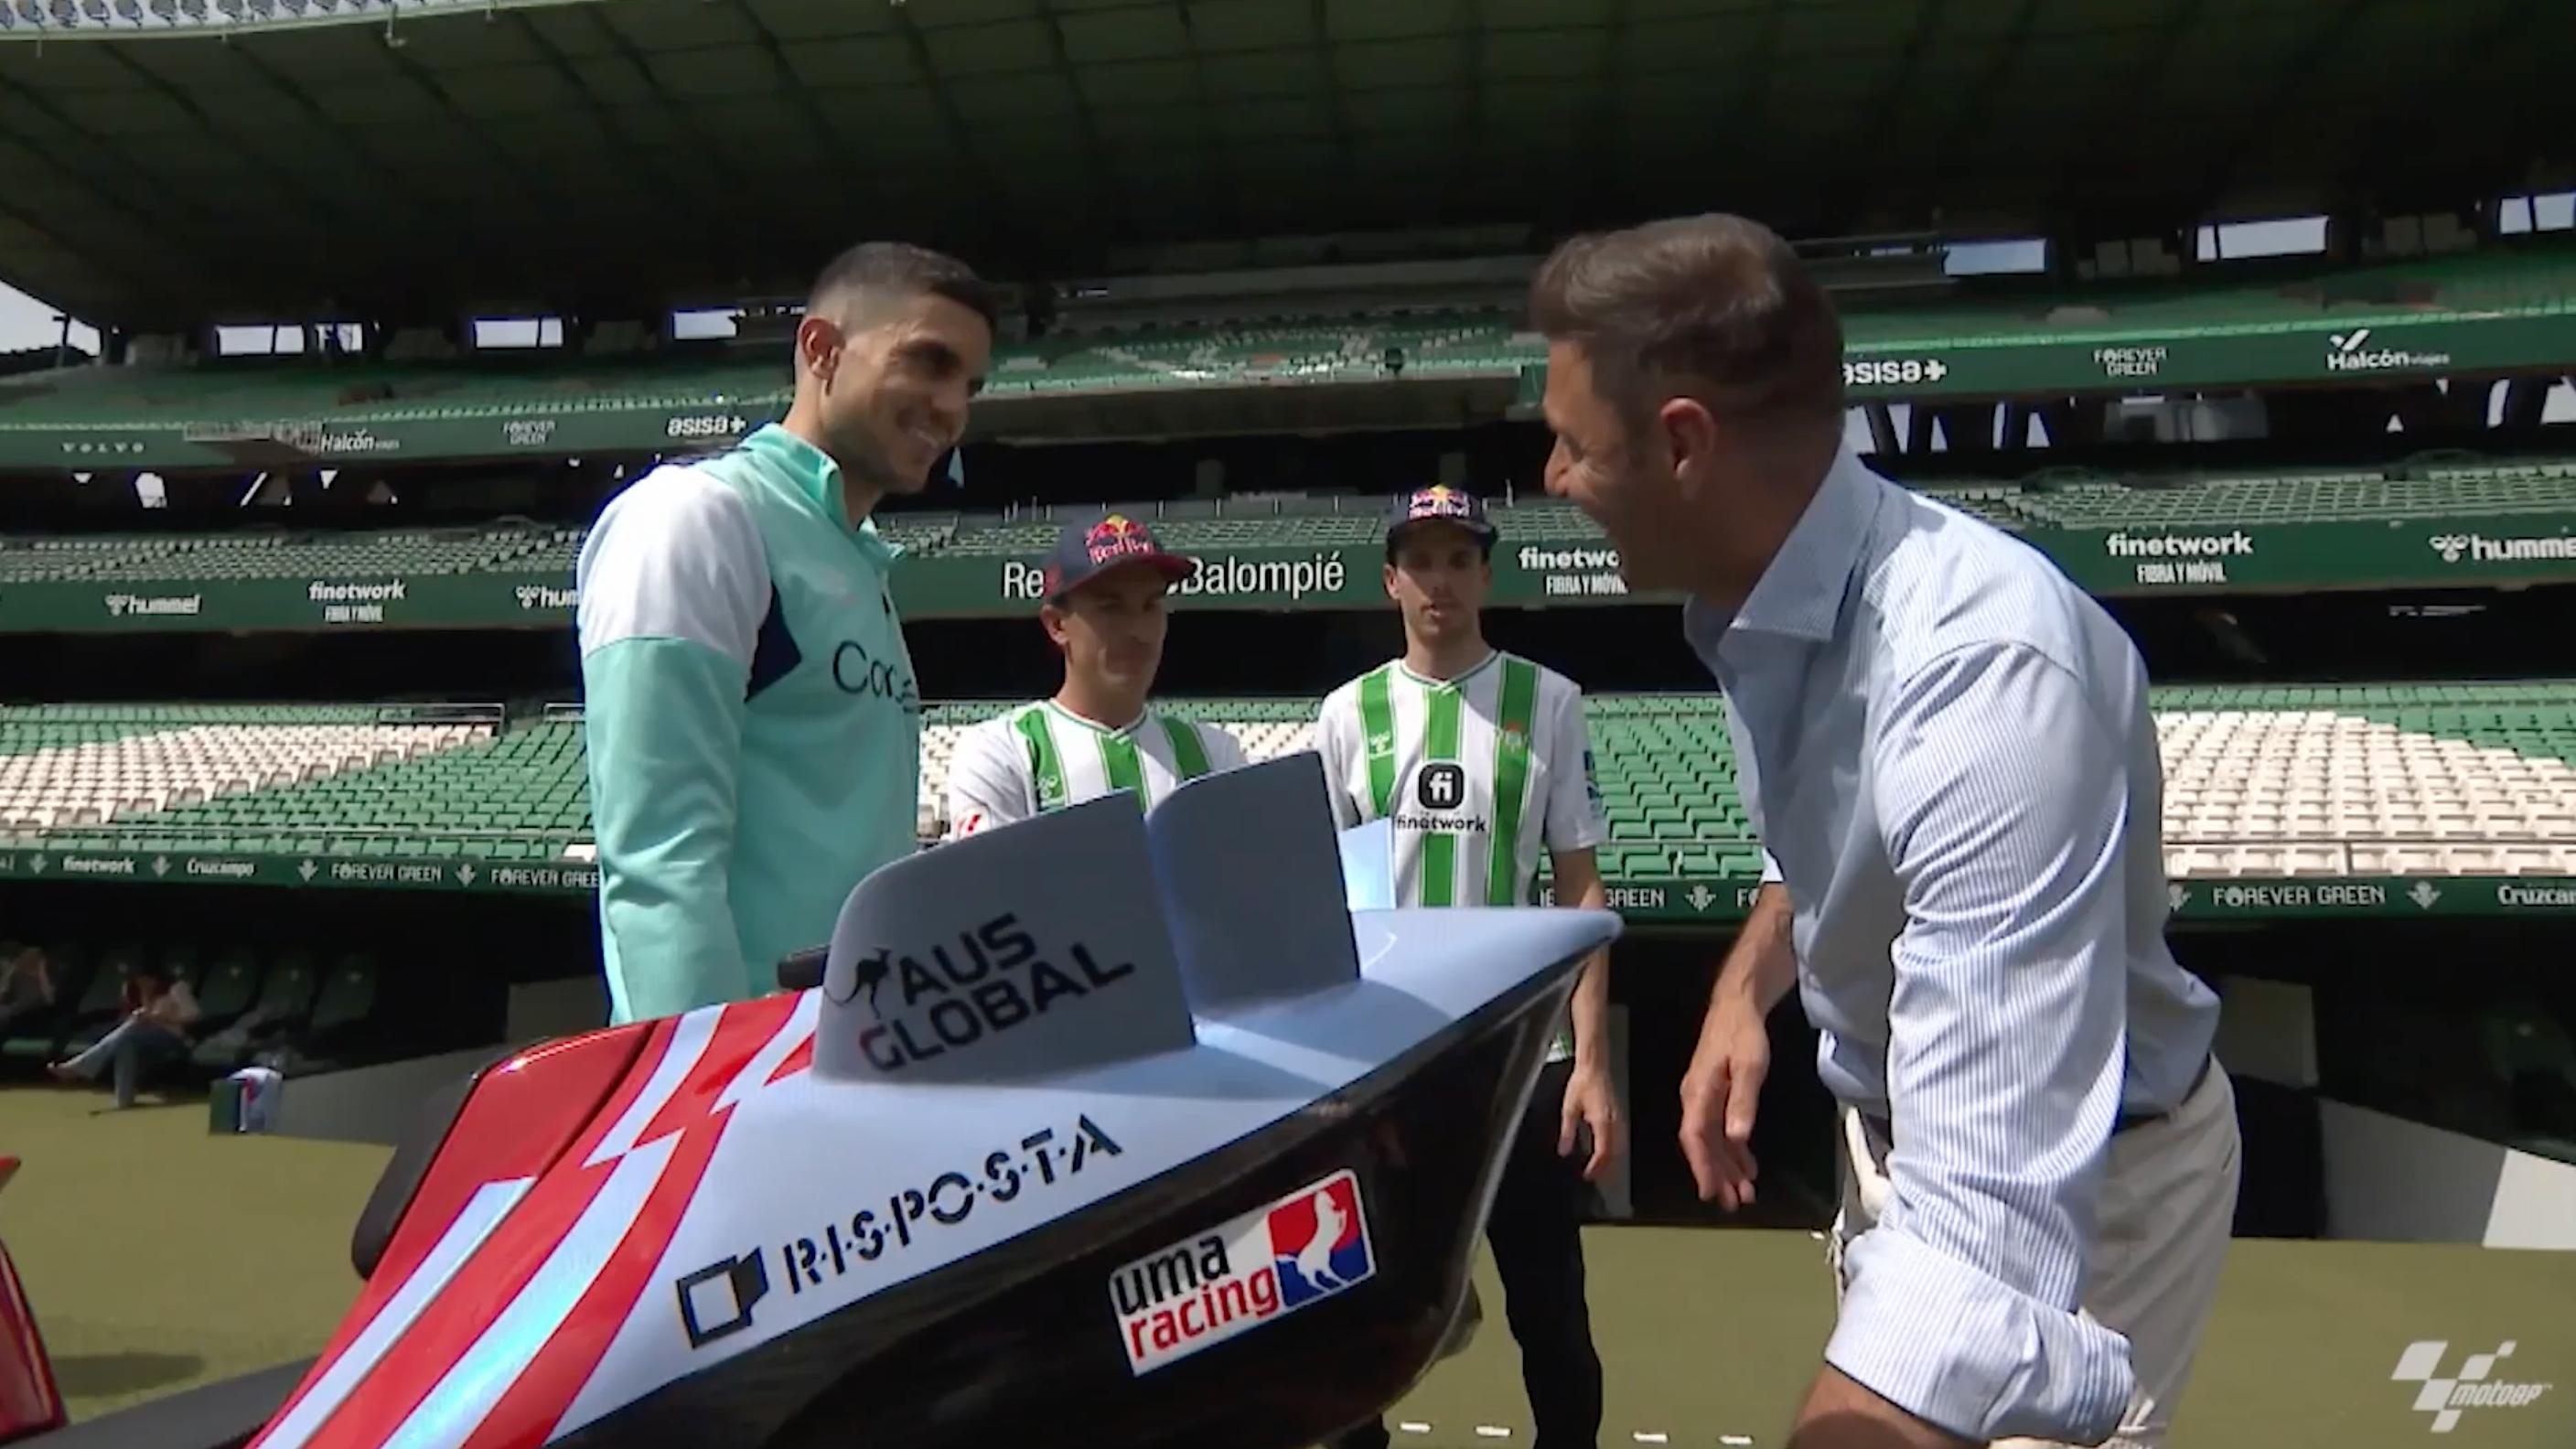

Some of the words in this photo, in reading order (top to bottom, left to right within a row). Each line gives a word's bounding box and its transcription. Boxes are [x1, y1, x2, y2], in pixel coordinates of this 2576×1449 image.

[2094, 347, 2167, 364] FOREVER
[2326, 349, 2410, 370] Halcón
[2107, 361, 2157, 377] GREEN
[61, 442, 145, 454] VOLVO
[2106, 531, 2253, 556] finetwork
[2472, 534, 2576, 560] humme
[1519, 546, 1622, 569] finetwo
[1003, 561, 1045, 598] Re
[1181, 551, 1345, 600] Balompié
[1545, 574, 1582, 596] FIBRA
[1581, 574, 1590, 595] Y
[309, 578, 406, 600] finetwork
[541, 586, 578, 607] hum
[129, 594, 200, 614] hummel
[1429, 771, 1454, 802] fi
[1397, 814, 1486, 832] finetwork
[62, 855, 134, 874] finetwork
[331, 863, 394, 880] FOREVER
[398, 865, 442, 882] GREEN
[490, 867, 558, 886] FOREVER
[562, 871, 598, 888] GREE
[2213, 886, 2311, 907] FOREVER
[2317, 886, 2385, 905] GREEN
[2497, 885, 2576, 905] Cruzca
[898, 912, 1036, 1006] AUS
[858, 942, 1136, 1072] GLOBAL
[1113, 1235, 1230, 1315] uma
[1129, 1266, 1280, 1359] racing
